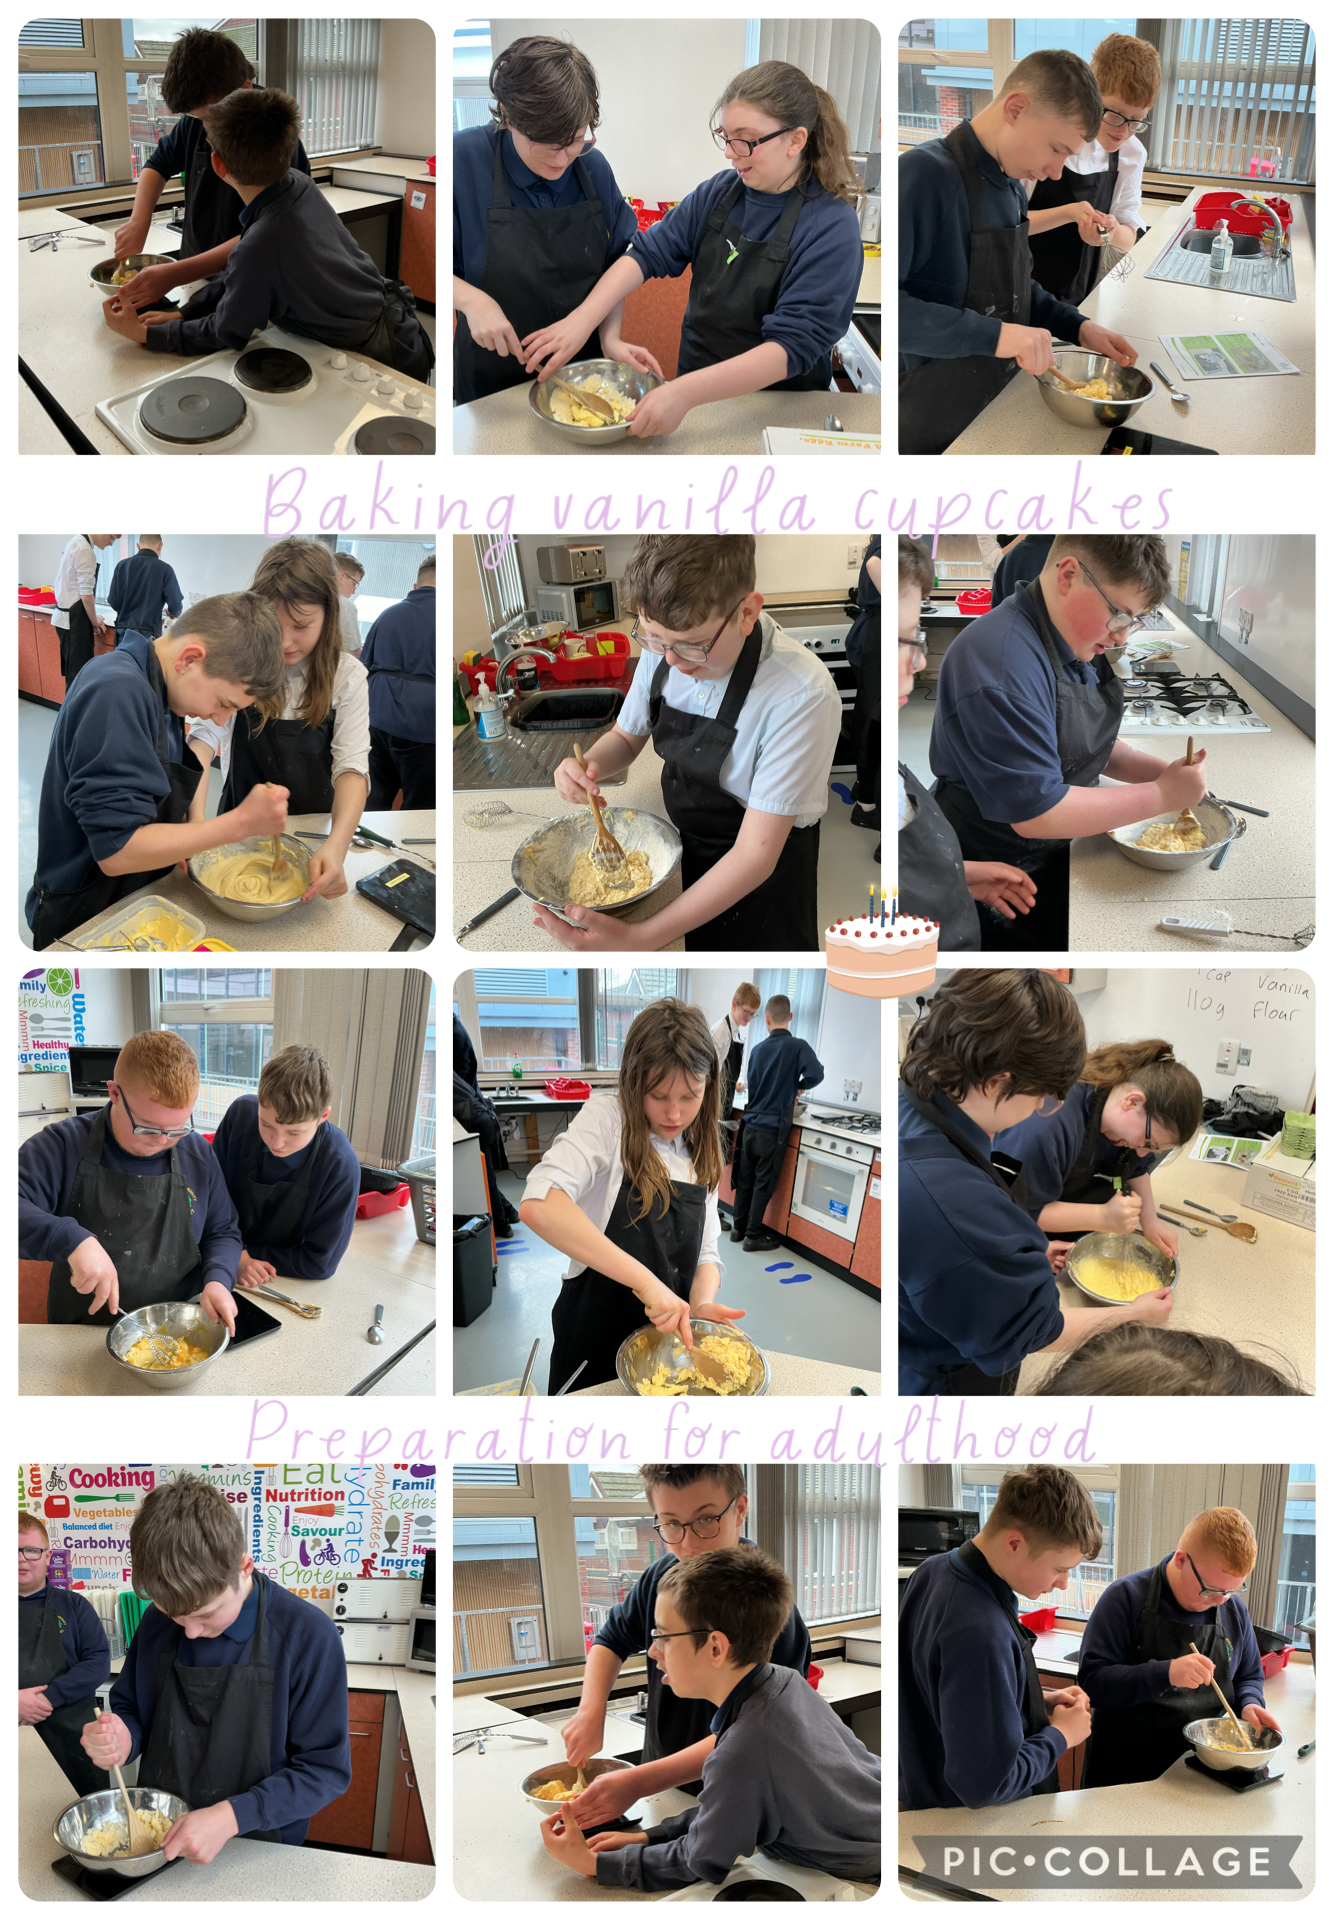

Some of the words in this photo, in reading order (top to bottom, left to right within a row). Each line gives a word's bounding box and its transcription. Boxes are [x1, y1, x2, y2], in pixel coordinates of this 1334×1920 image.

[18, 980, 47, 993] mily
[1258, 975, 1310, 1000] Vanilla
[32, 1040, 70, 1051] Healthy
[69, 1466, 155, 1493] Cooking
[283, 1464, 342, 1485] Eat
[392, 1478, 436, 1493] Famil
[265, 1488, 345, 1503] Nutrition
[73, 1507, 138, 1520] Vegetables
[251, 1470, 265, 1563] Ingredients
[62, 1523, 98, 1531] Balanced
[98, 1523, 113, 1531] diet
[292, 1516, 320, 1527] Enjoy
[260, 1505, 282, 1563] Cooking
[291, 1525, 345, 1537] Savour
[92, 1567, 120, 1580] Water
